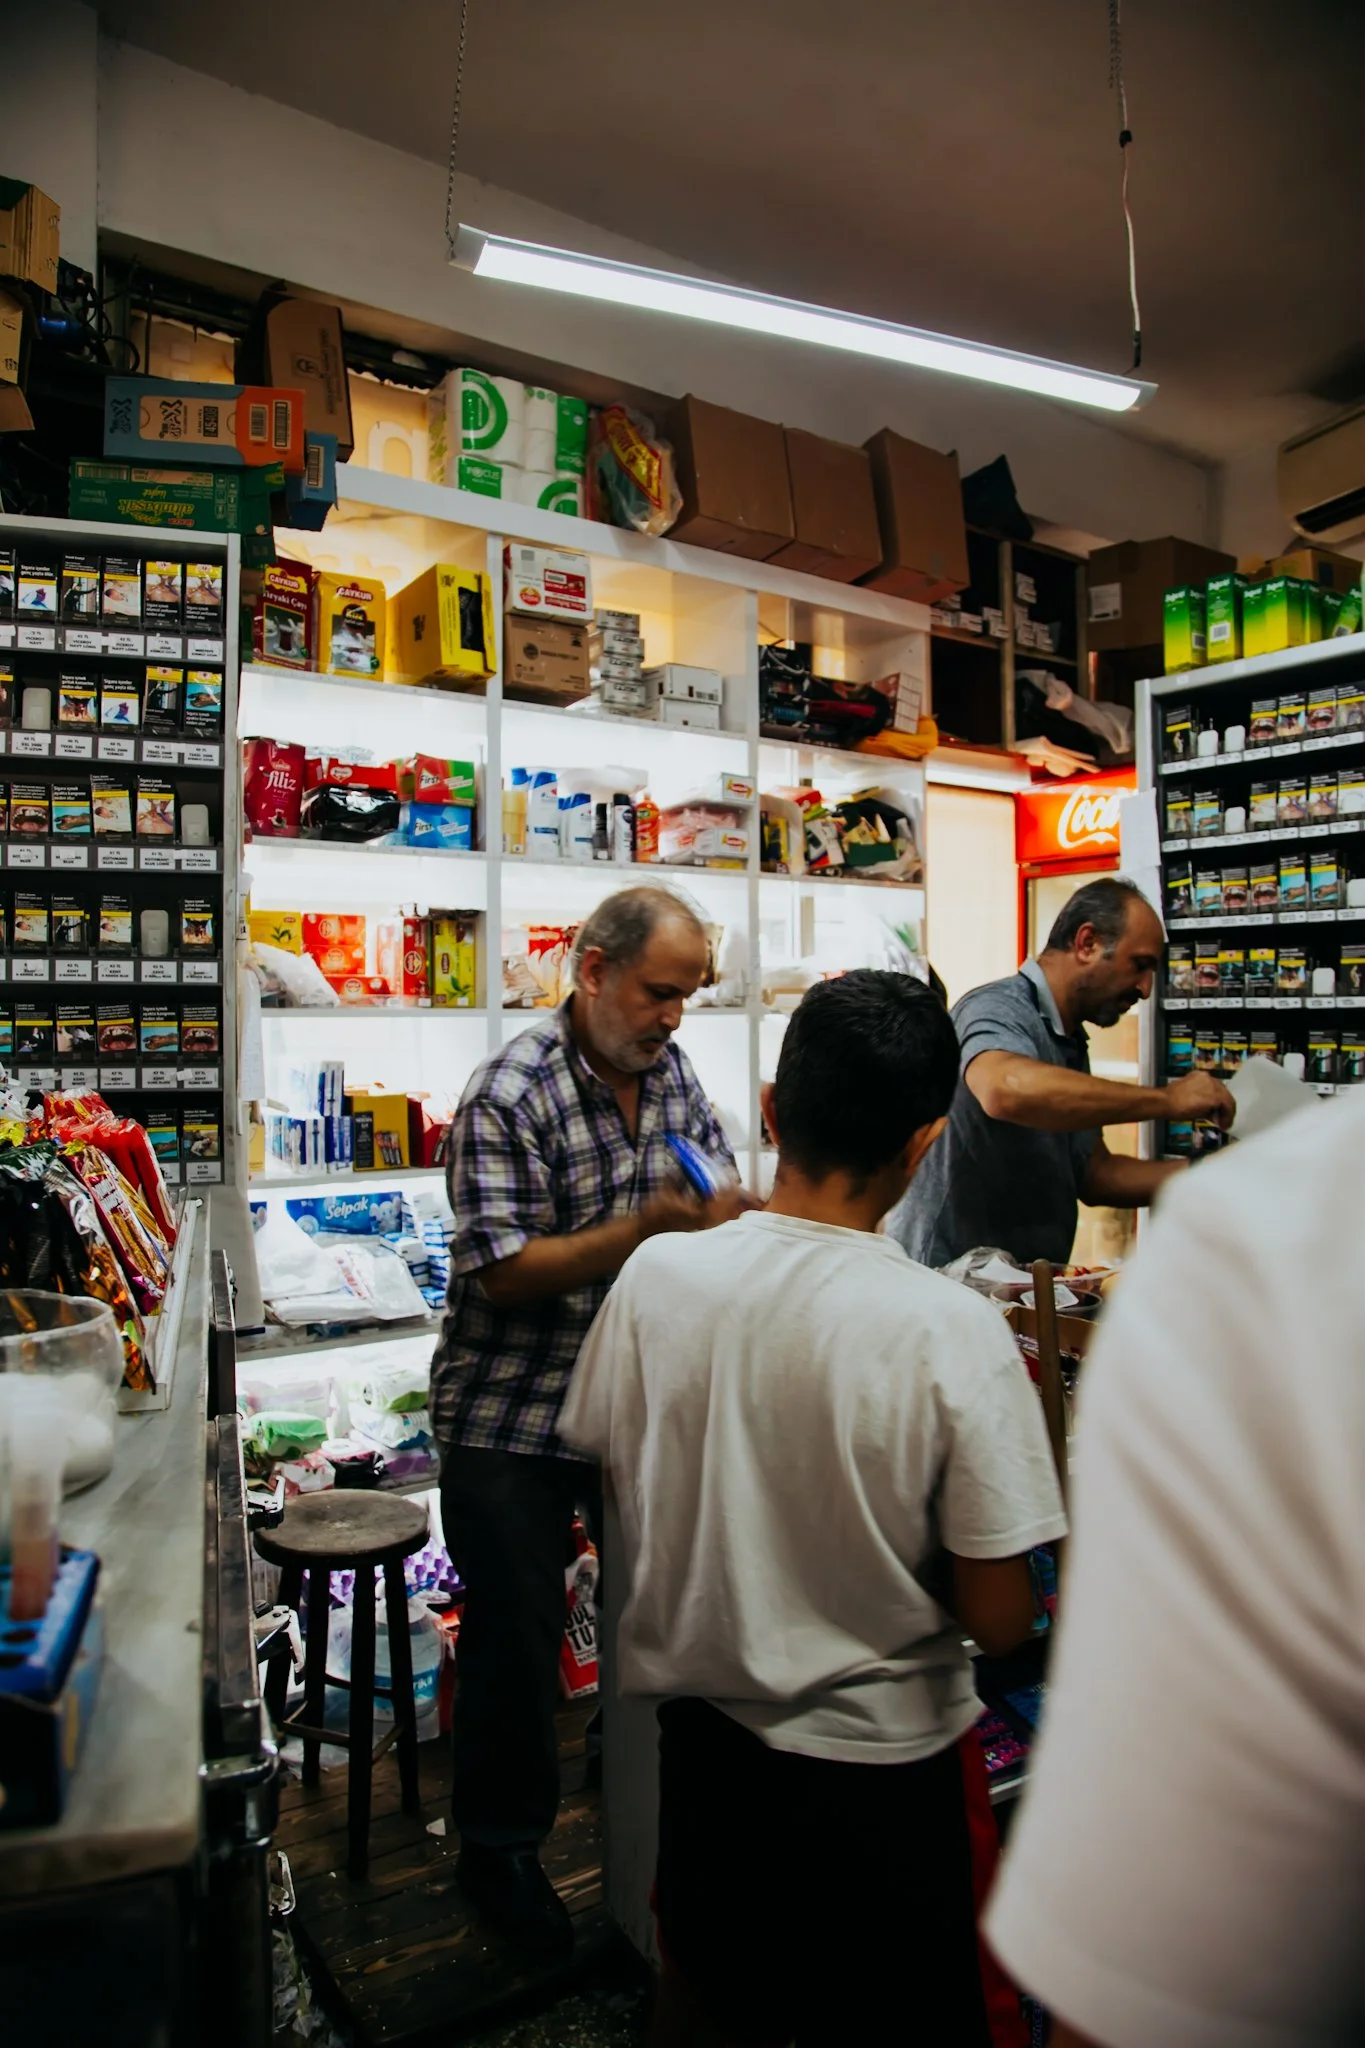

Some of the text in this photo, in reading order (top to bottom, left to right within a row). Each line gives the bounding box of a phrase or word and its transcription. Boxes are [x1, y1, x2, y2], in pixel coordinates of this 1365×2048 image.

[466, 466, 500, 479] FOCUS
[265, 770, 297, 791] filiz
[420, 774, 440, 785] First
[415, 822, 434, 832] First
[325, 1196, 369, 1221] Selpak
